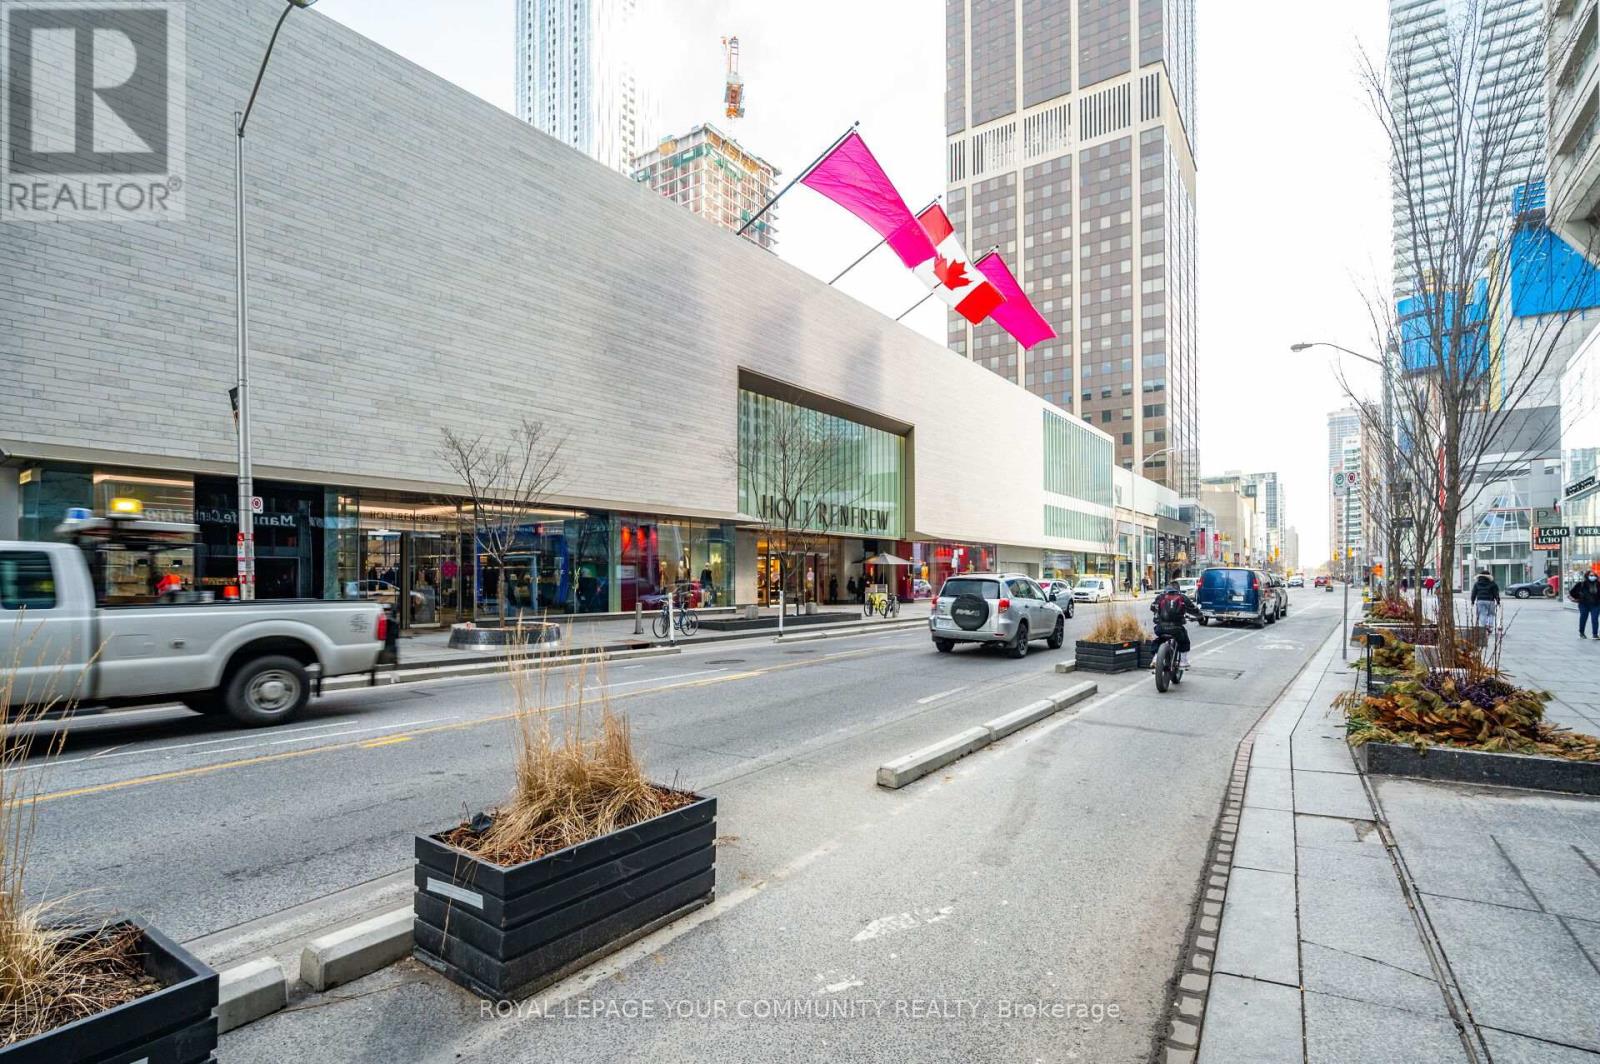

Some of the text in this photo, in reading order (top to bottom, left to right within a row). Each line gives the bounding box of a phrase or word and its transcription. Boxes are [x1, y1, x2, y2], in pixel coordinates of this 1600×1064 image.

[762, 494, 889, 531] HOLT RENFREW
[1541, 528, 1567, 536] LCBO
